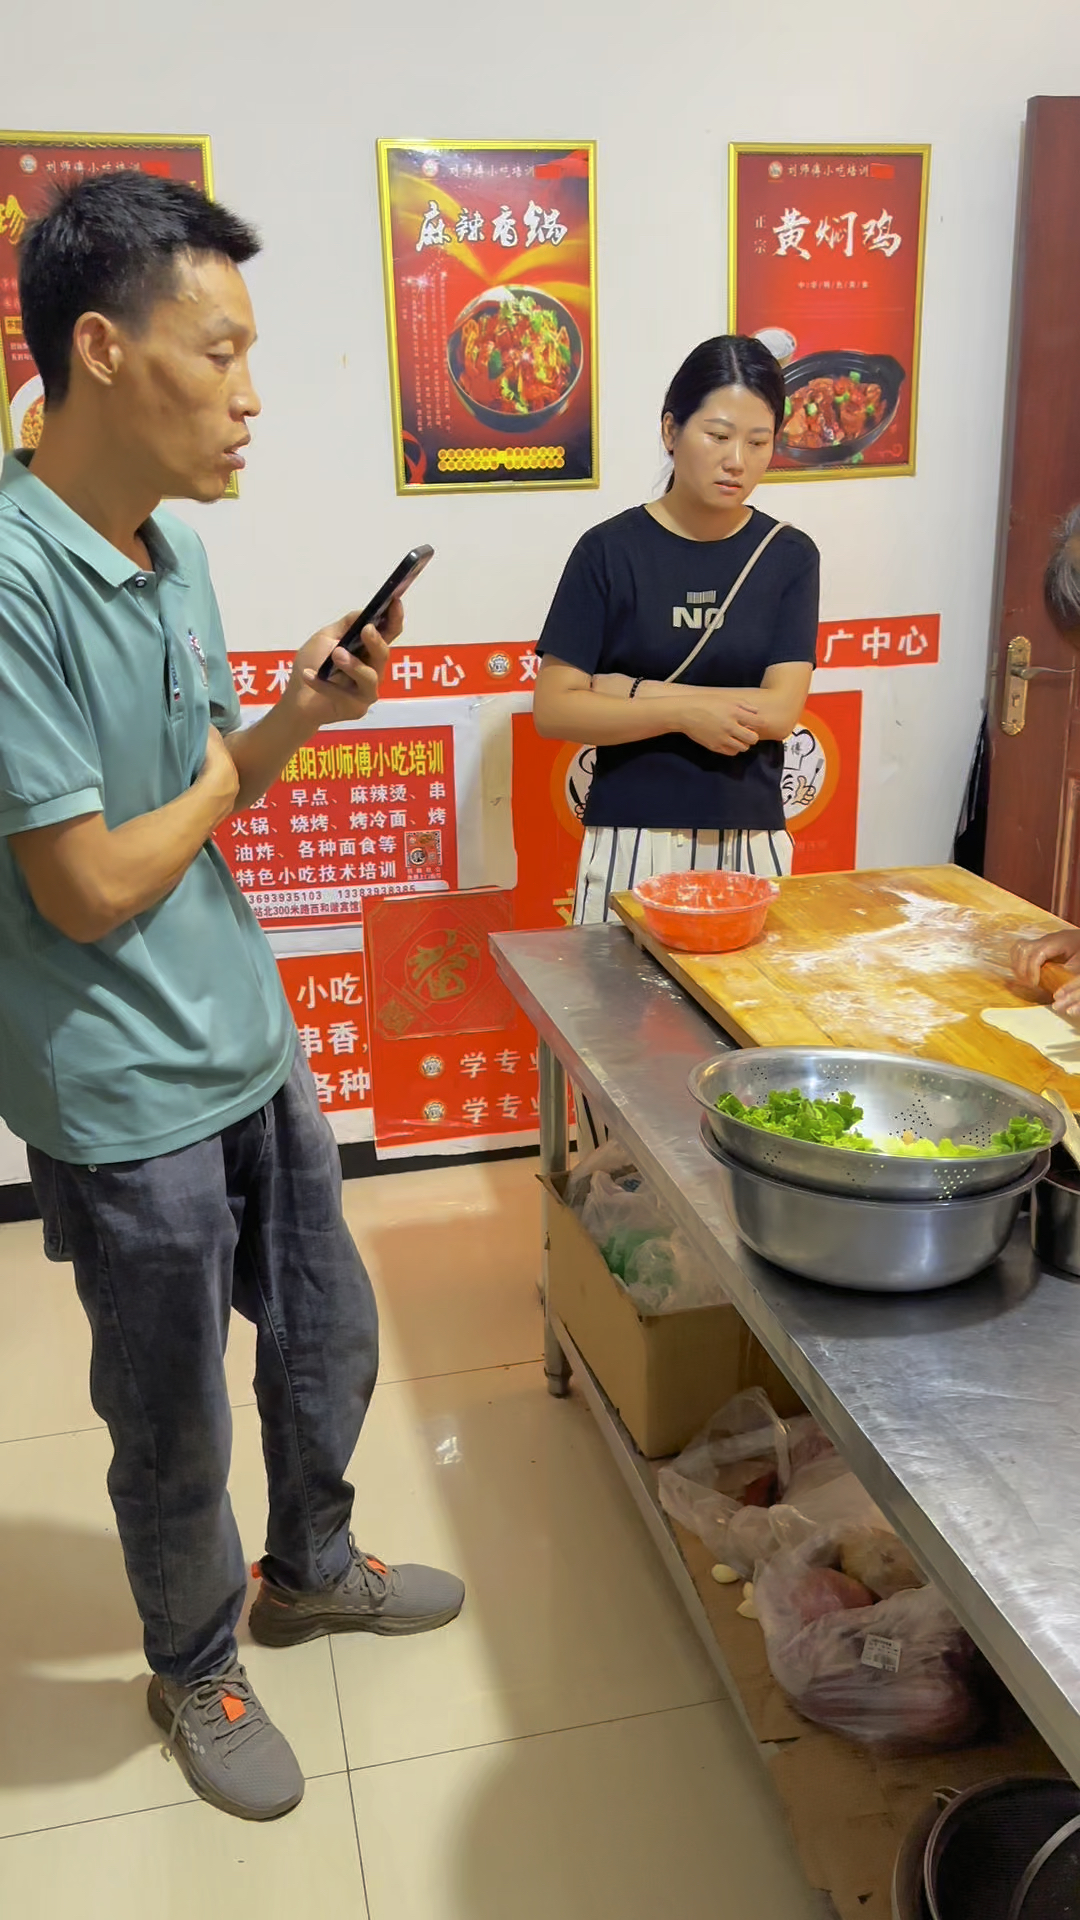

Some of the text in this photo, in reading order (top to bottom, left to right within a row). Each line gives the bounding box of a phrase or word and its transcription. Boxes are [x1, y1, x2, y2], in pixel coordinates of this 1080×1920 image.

[787, 162, 870, 178] 刘师傅小吃培训
[415, 199, 568, 252] 麻辣香锅
[754, 214, 768, 255] 正宗
[772, 207, 902, 261] 黄焖鸡
[672, 606, 725, 630] NO
[823, 624, 929, 663] 广中心
[229, 659, 294, 697] 技术
[391, 654, 466, 690] 中心
[280, 740, 445, 783] 濮阳刘师傅小吃培训
[234, 835, 398, 862] 油炸、各种面食等
[235, 860, 397, 888] 特色小吃技术培训
[296, 971, 363, 1010] 小吃
[312, 1066, 371, 1104] 各种
